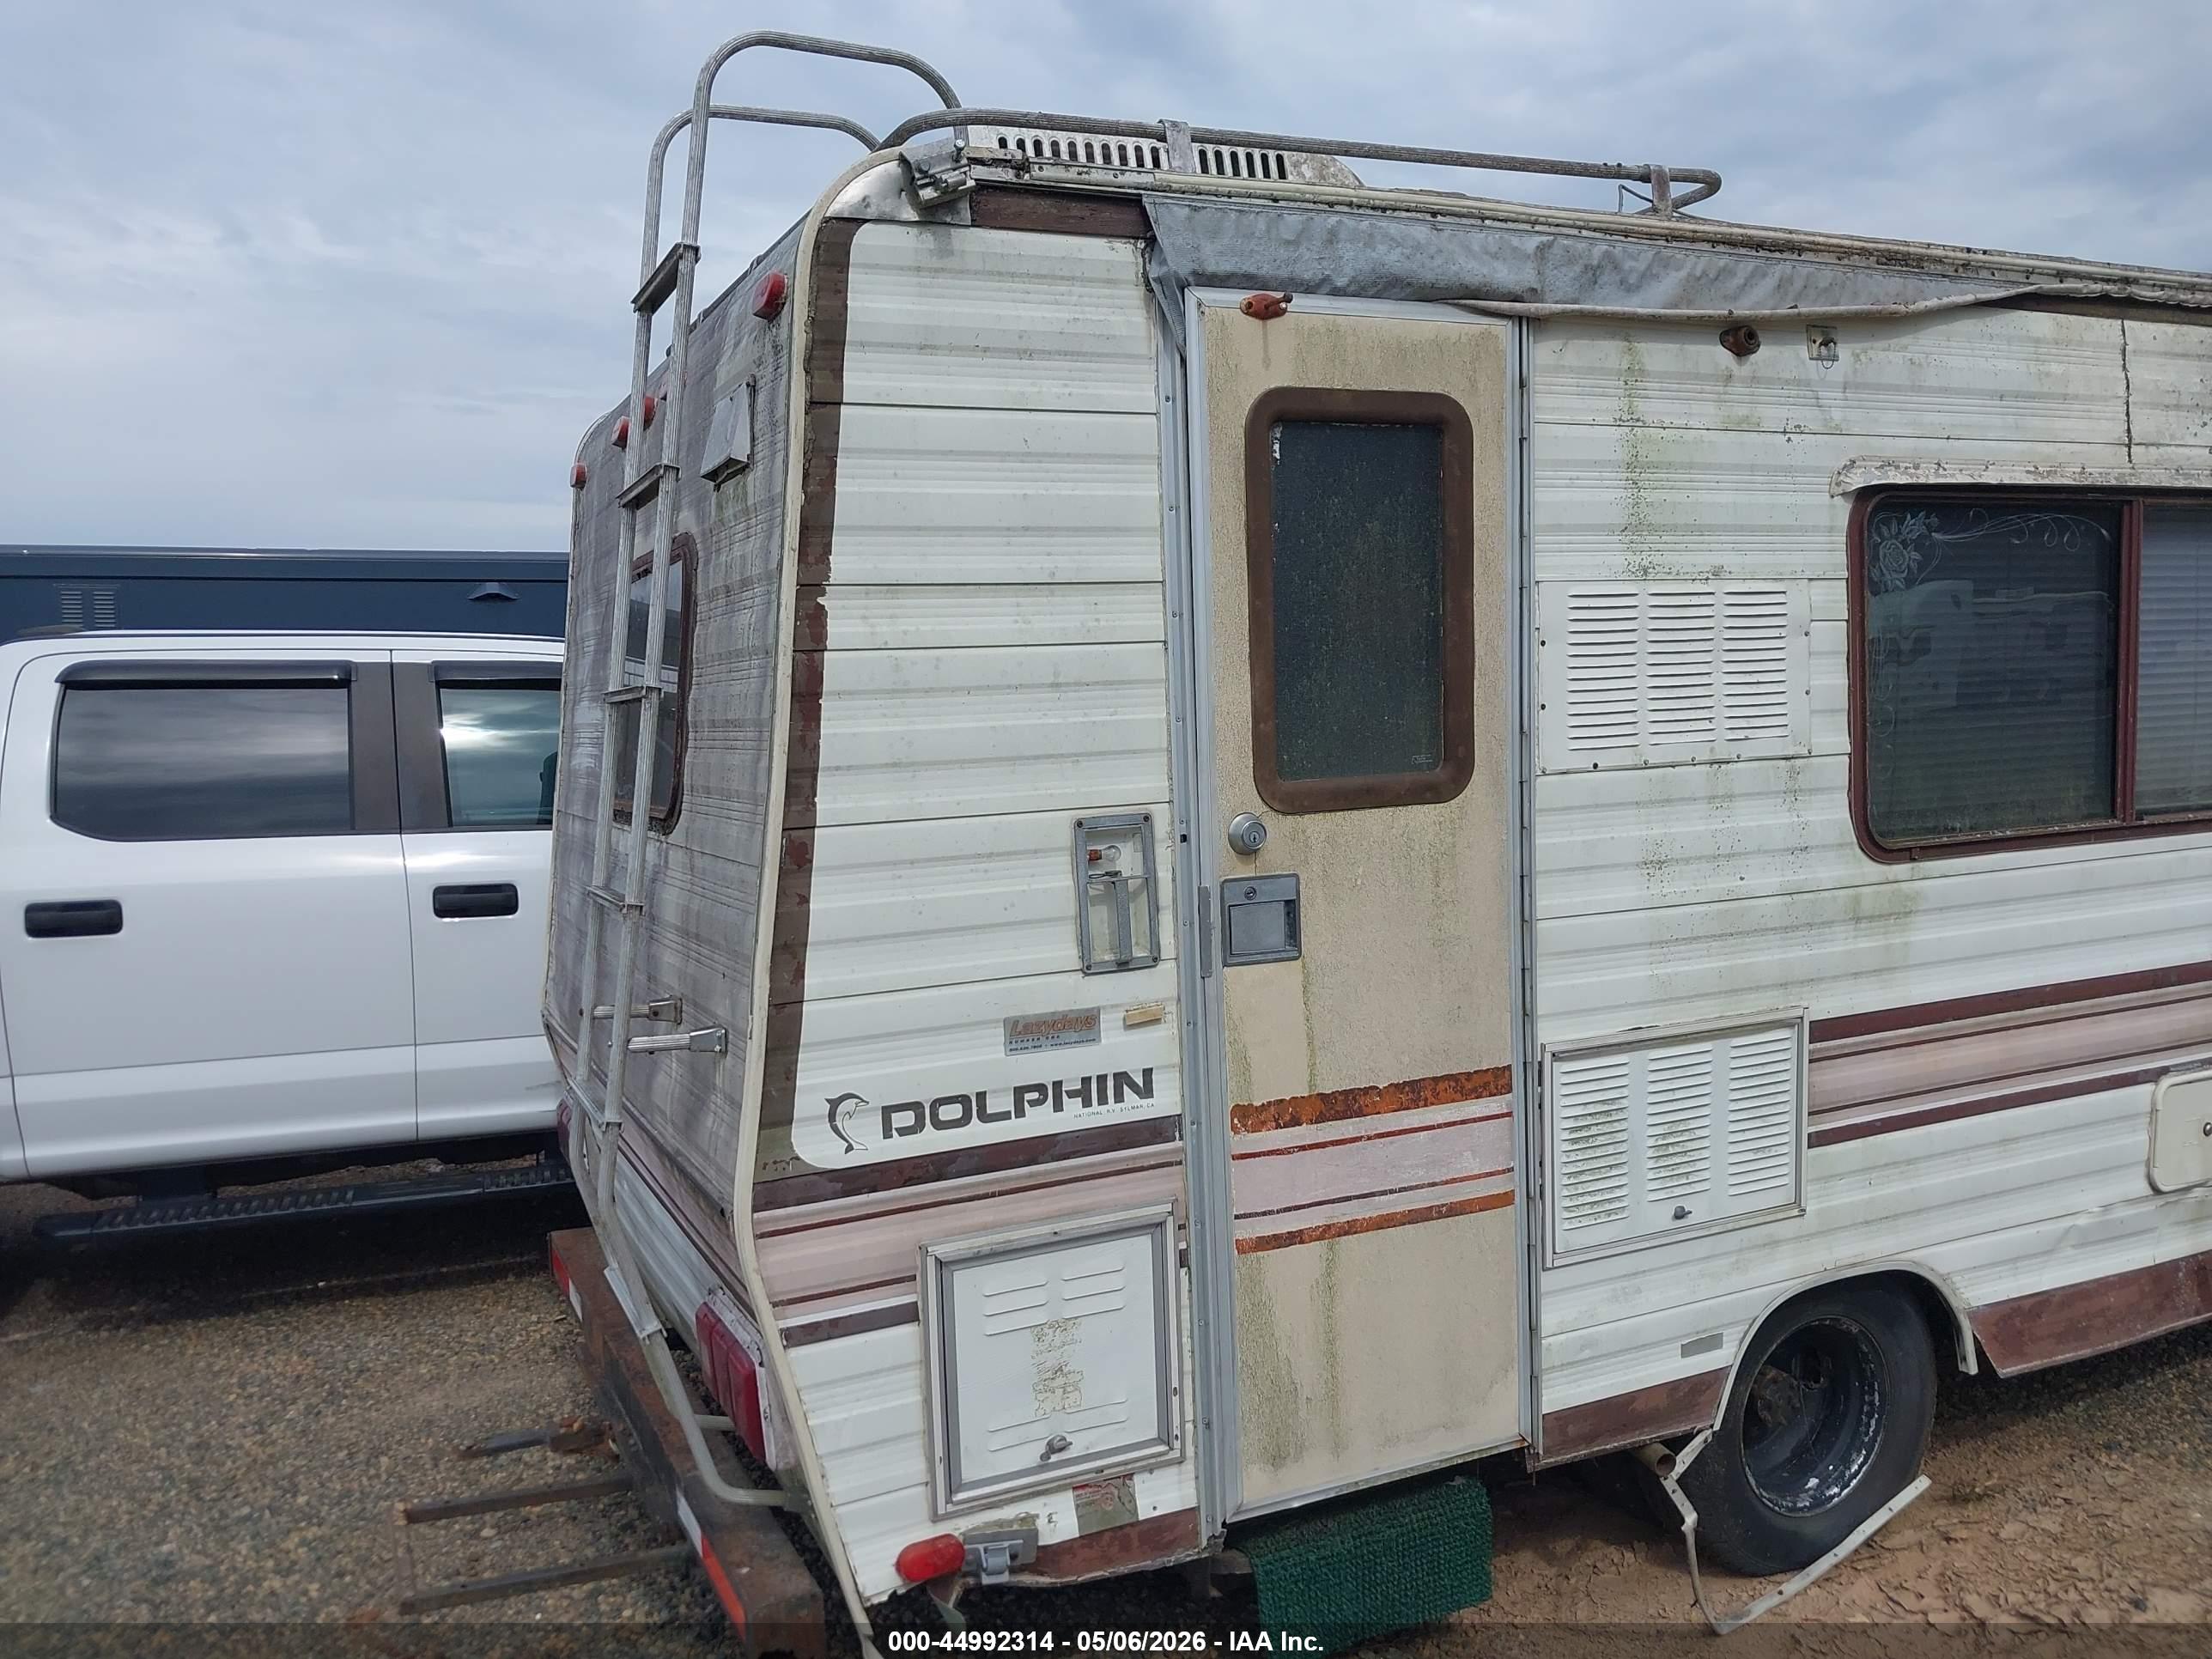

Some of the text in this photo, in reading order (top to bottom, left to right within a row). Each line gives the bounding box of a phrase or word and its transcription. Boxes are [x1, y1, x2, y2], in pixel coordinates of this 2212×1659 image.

[1009, 1014, 1097, 1037] Lazydays
[881, 1066, 1155, 1140] DOLPHIN
[1073, 1109, 1103, 1119] NATIONAL
